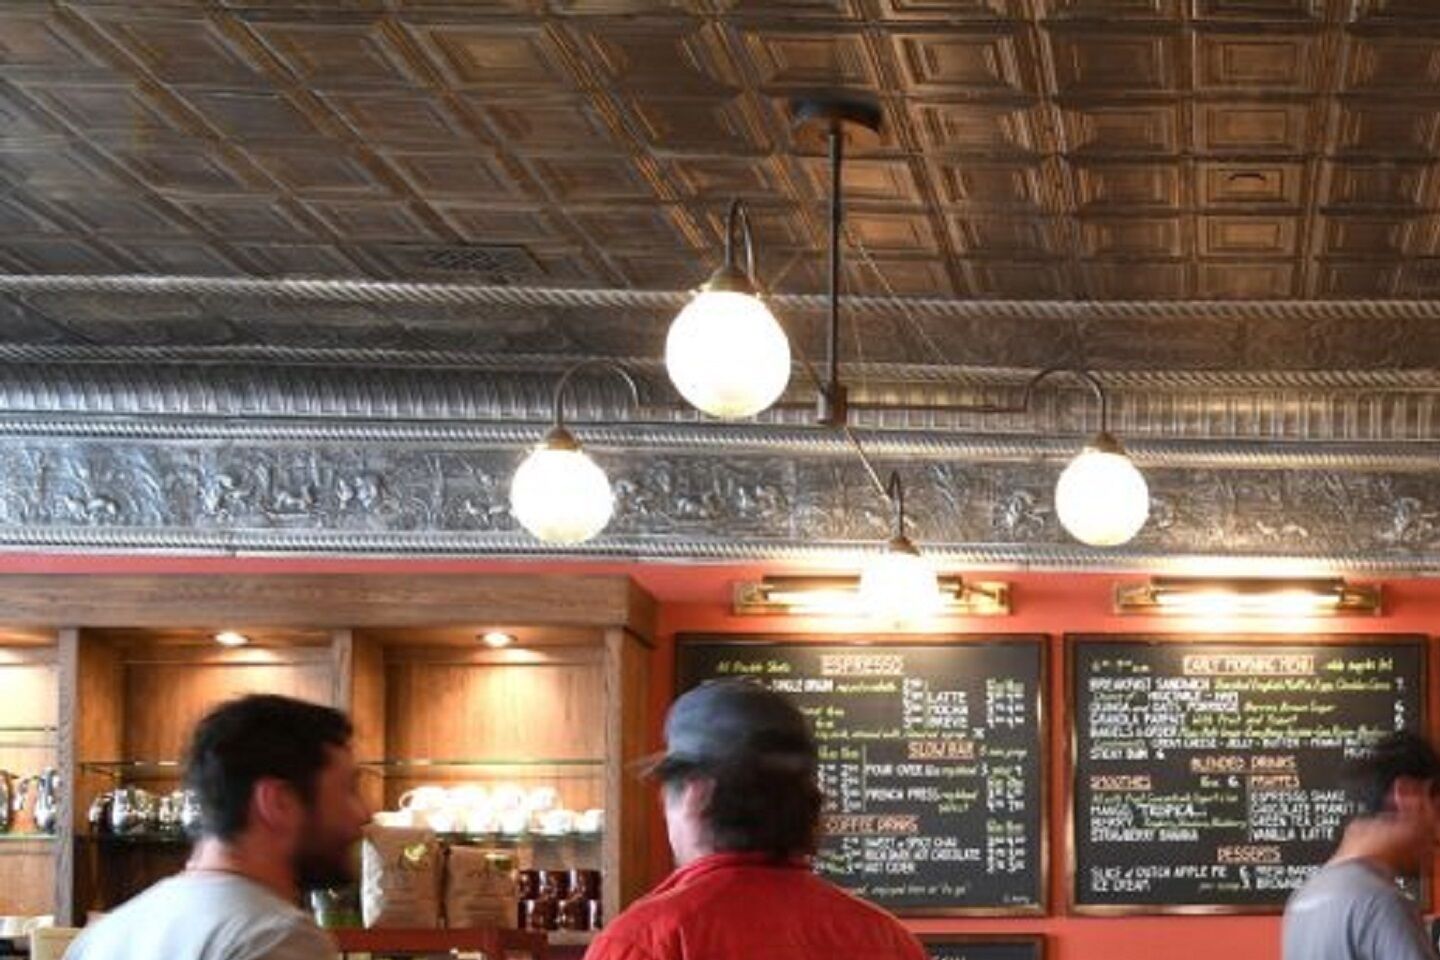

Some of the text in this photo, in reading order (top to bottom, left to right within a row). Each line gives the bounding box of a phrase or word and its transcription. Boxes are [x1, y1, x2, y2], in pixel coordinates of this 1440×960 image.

[820, 655, 904, 676] ESPRESSO
[1089, 677, 1151, 691] BREAKFAST
[1155, 677, 1210, 690] SANDWICH
[927, 691, 967, 703] LATTE
[908, 741, 945, 759] SLOW
[1250, 756, 1297, 770] DRINKS
[1251, 790, 1308, 802] ESPRESSO
[1251, 815, 1287, 827] GREEN
[1252, 827, 1335, 842] VANILLA LATTE
[1217, 845, 1282, 862] DESSERTS
[1174, 866, 1206, 878] APPLE
[1211, 866, 1227, 878] PIE
[1091, 879, 1111, 892] ICE
[1113, 879, 1151, 892] CREAM
